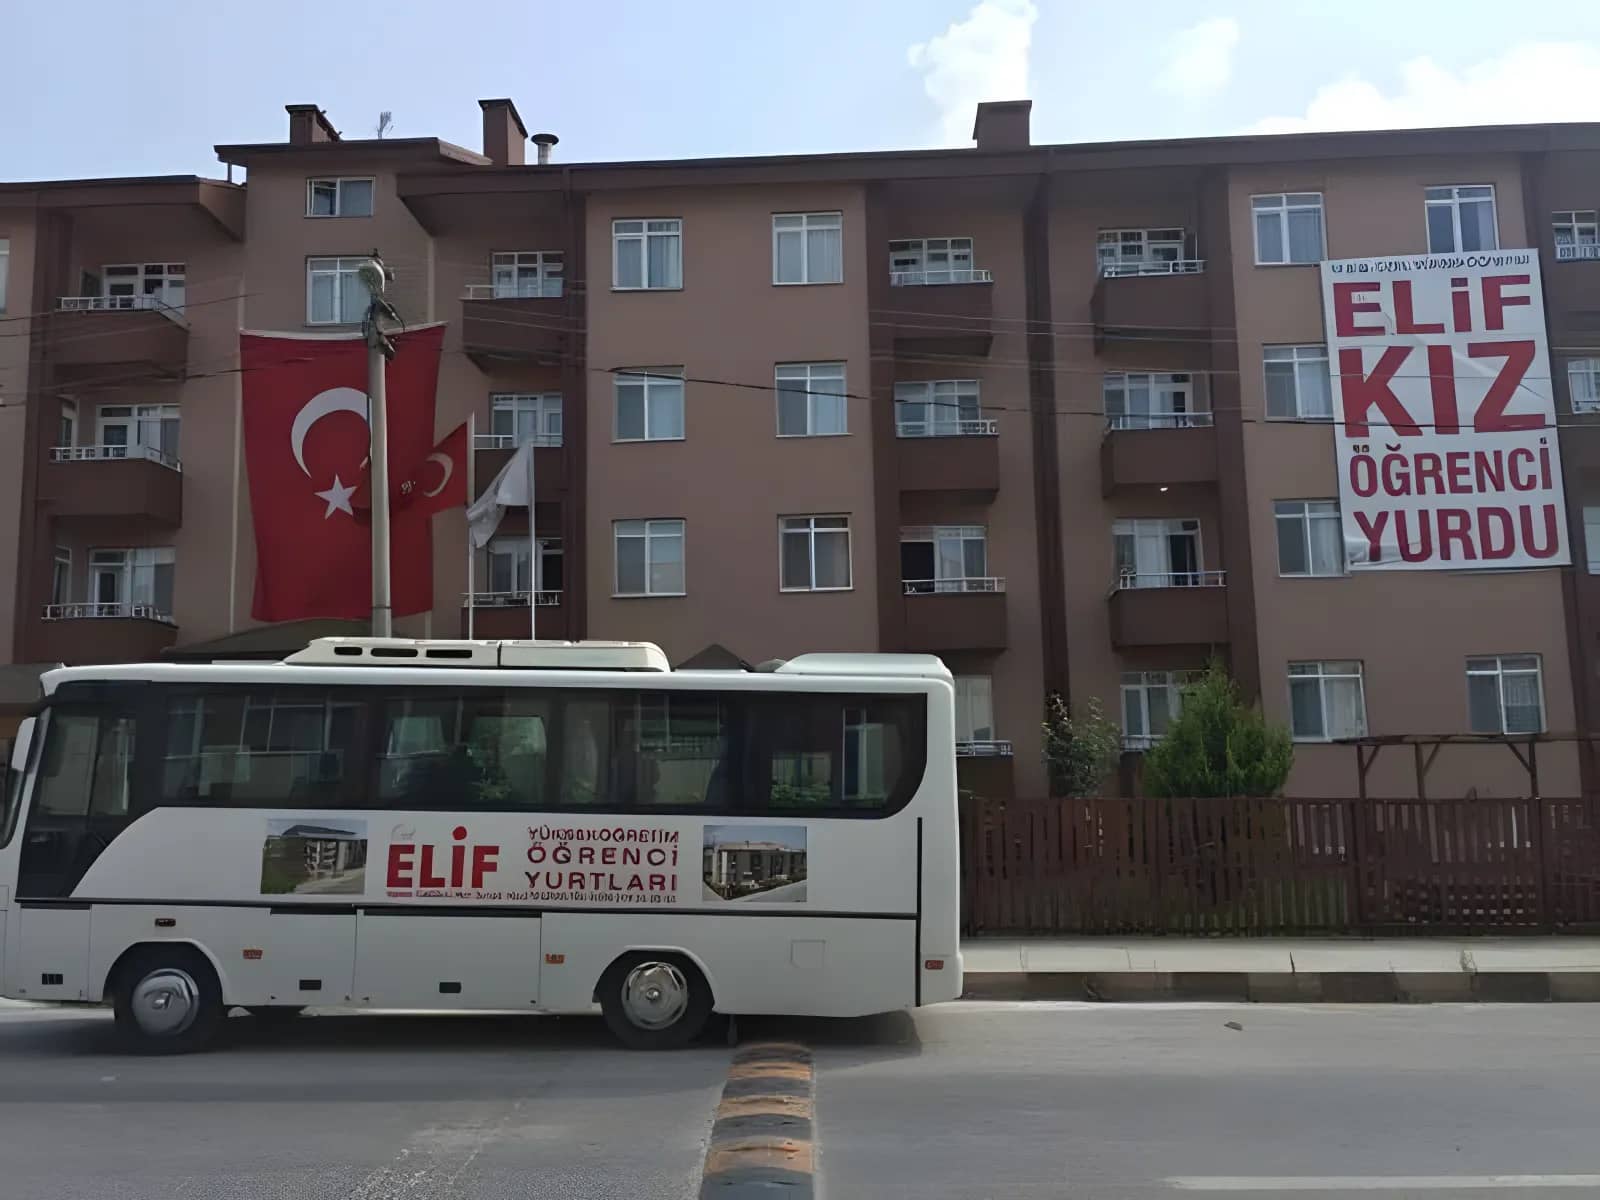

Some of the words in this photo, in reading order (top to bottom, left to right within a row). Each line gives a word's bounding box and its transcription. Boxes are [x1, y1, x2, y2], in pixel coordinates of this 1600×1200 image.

[1338, 340, 1546, 438] KIZ
[1350, 437, 1553, 498] ÖĞRENCİ
[1353, 504, 1560, 563] YURDU
[386, 826, 500, 889] ELİF
[524, 871, 678, 892] YURTLARI
